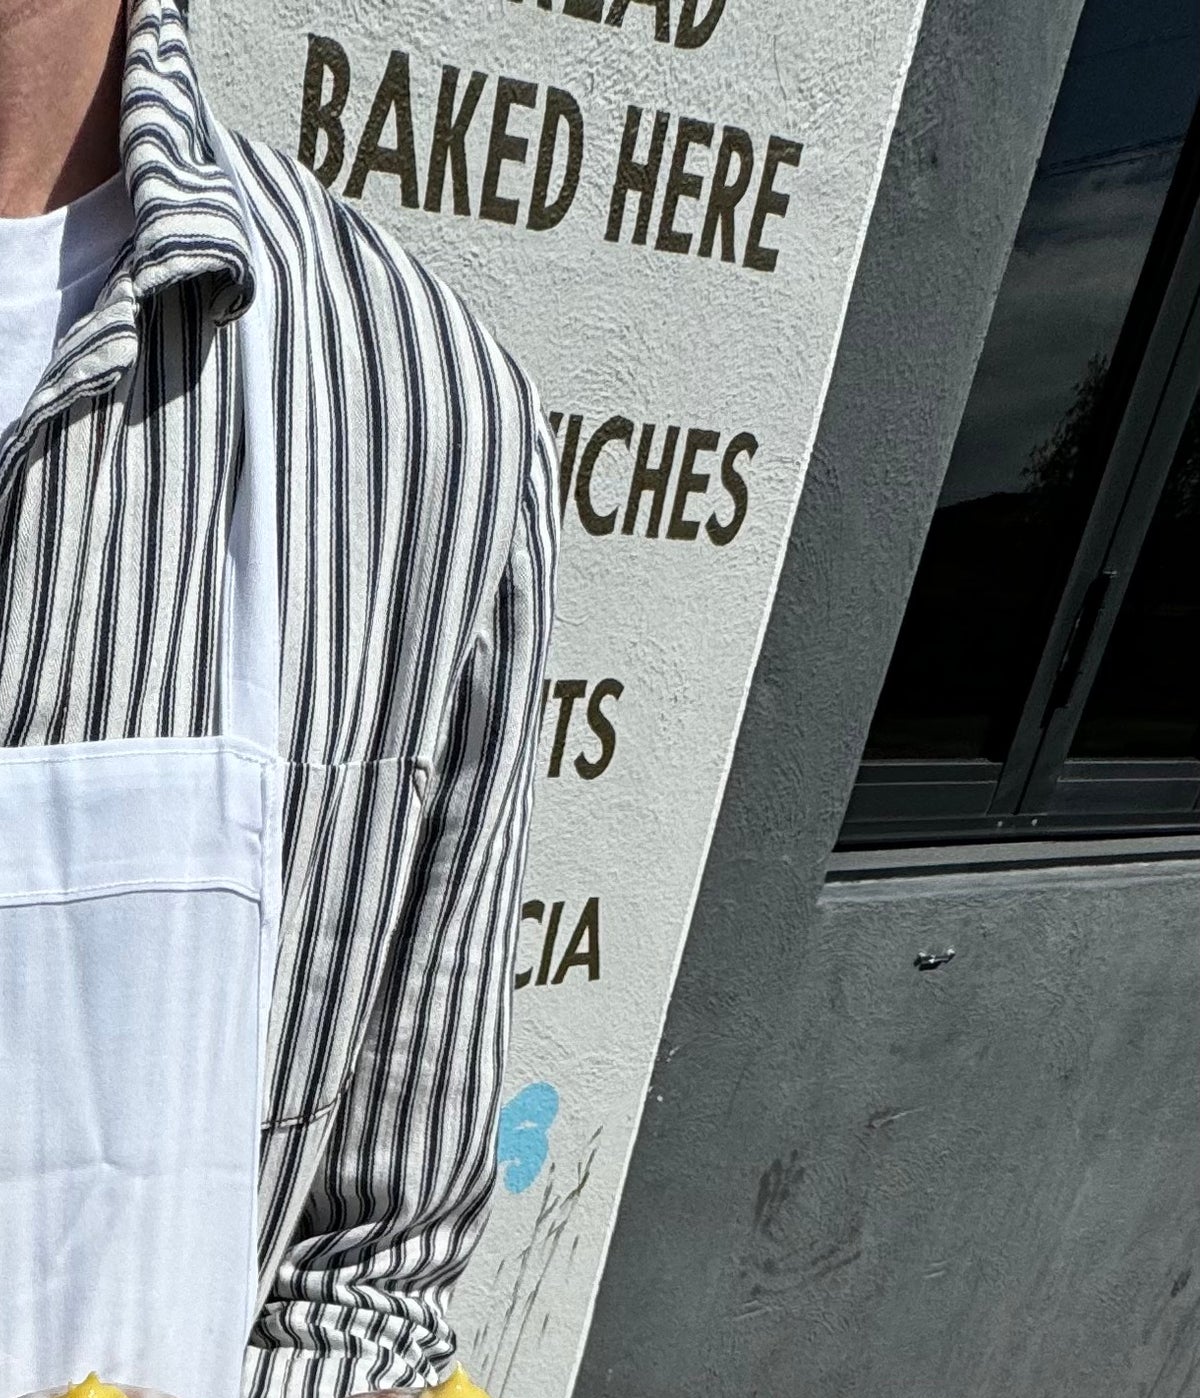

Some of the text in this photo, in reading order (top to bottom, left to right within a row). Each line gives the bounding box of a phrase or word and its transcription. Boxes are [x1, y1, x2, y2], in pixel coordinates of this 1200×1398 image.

[298, 32, 804, 273] BAKED HERE
[549, 410, 759, 546] ICHES
[538, 677, 624, 780] TS
